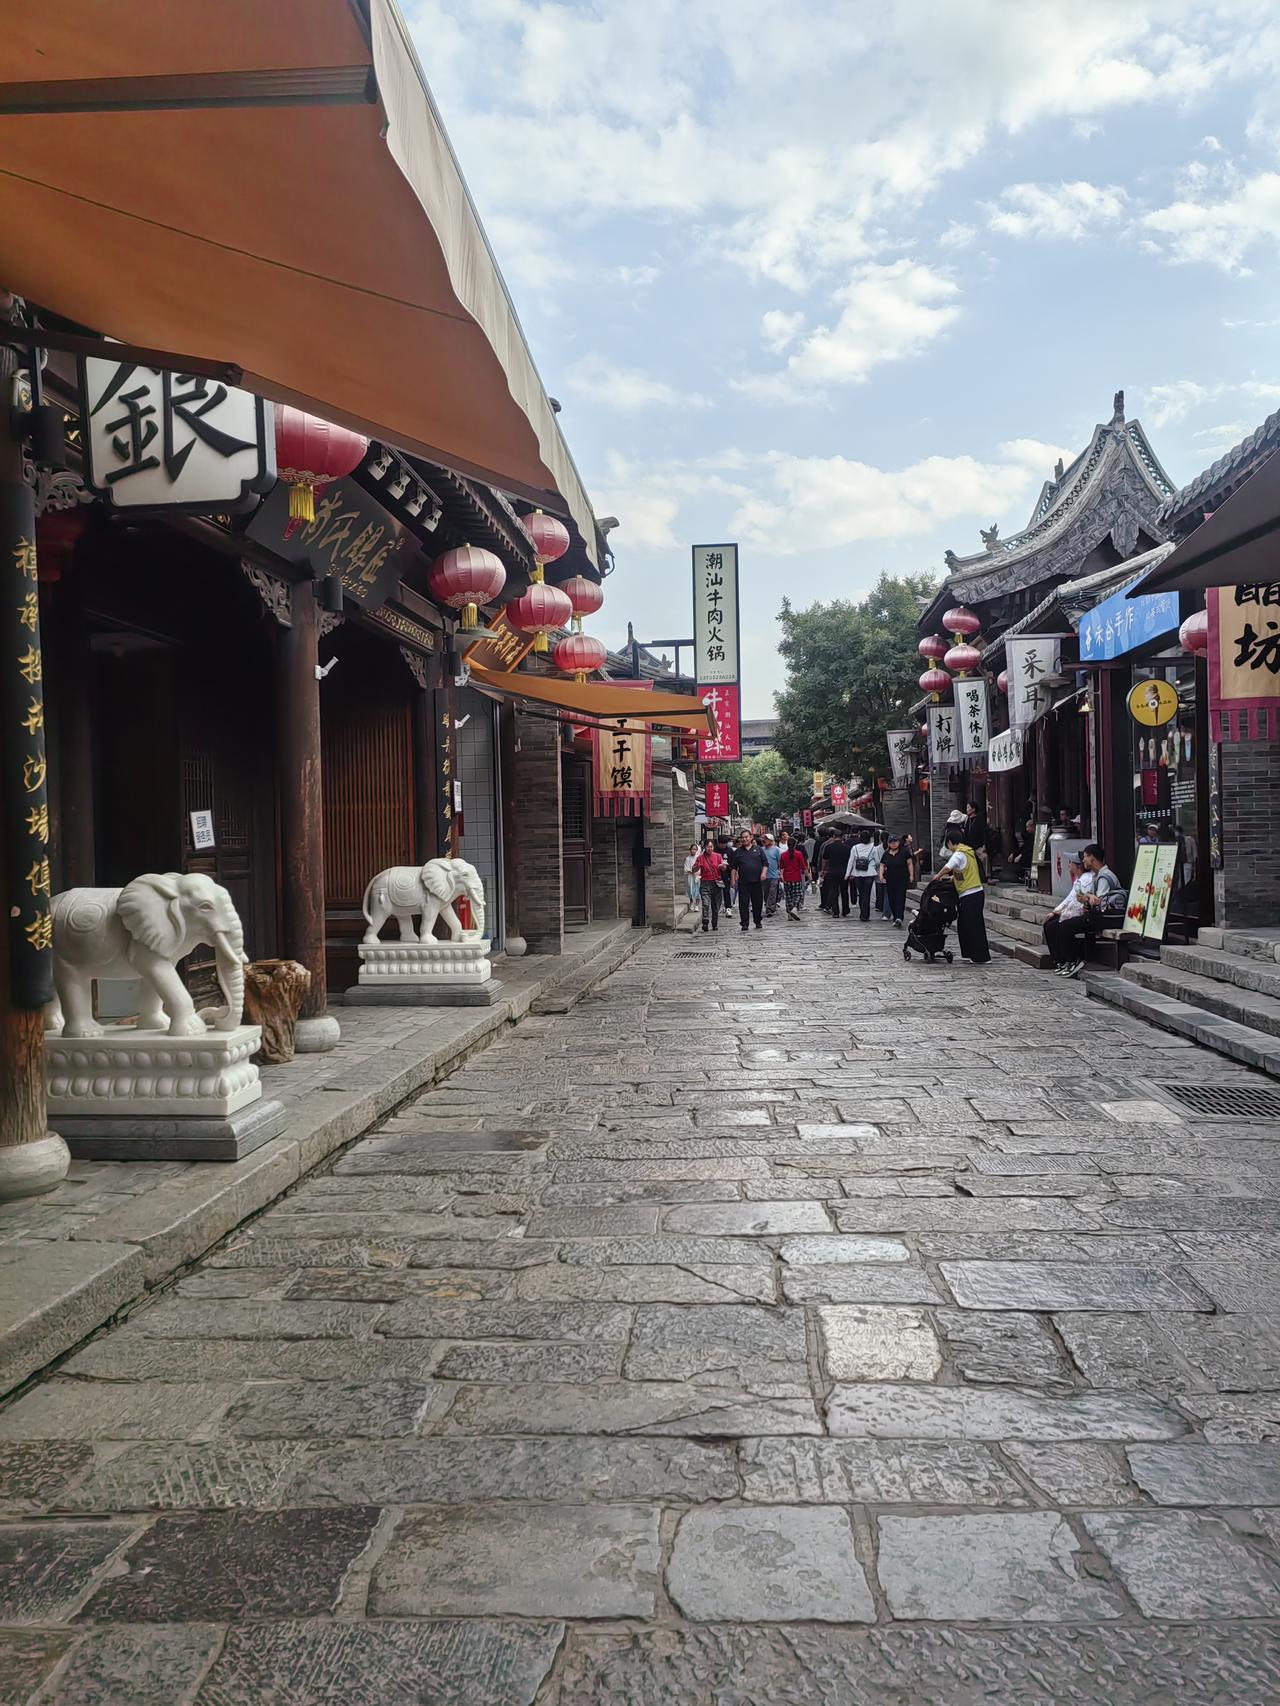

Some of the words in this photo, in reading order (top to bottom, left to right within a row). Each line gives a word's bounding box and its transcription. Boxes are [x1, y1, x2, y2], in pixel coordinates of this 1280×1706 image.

[705, 552, 725, 661] 潮汕牛肉火锅
[1022, 648, 1046, 710] 采耳
[936, 714, 955, 754] 打牌
[966, 690, 982, 749] 喝茶休息
